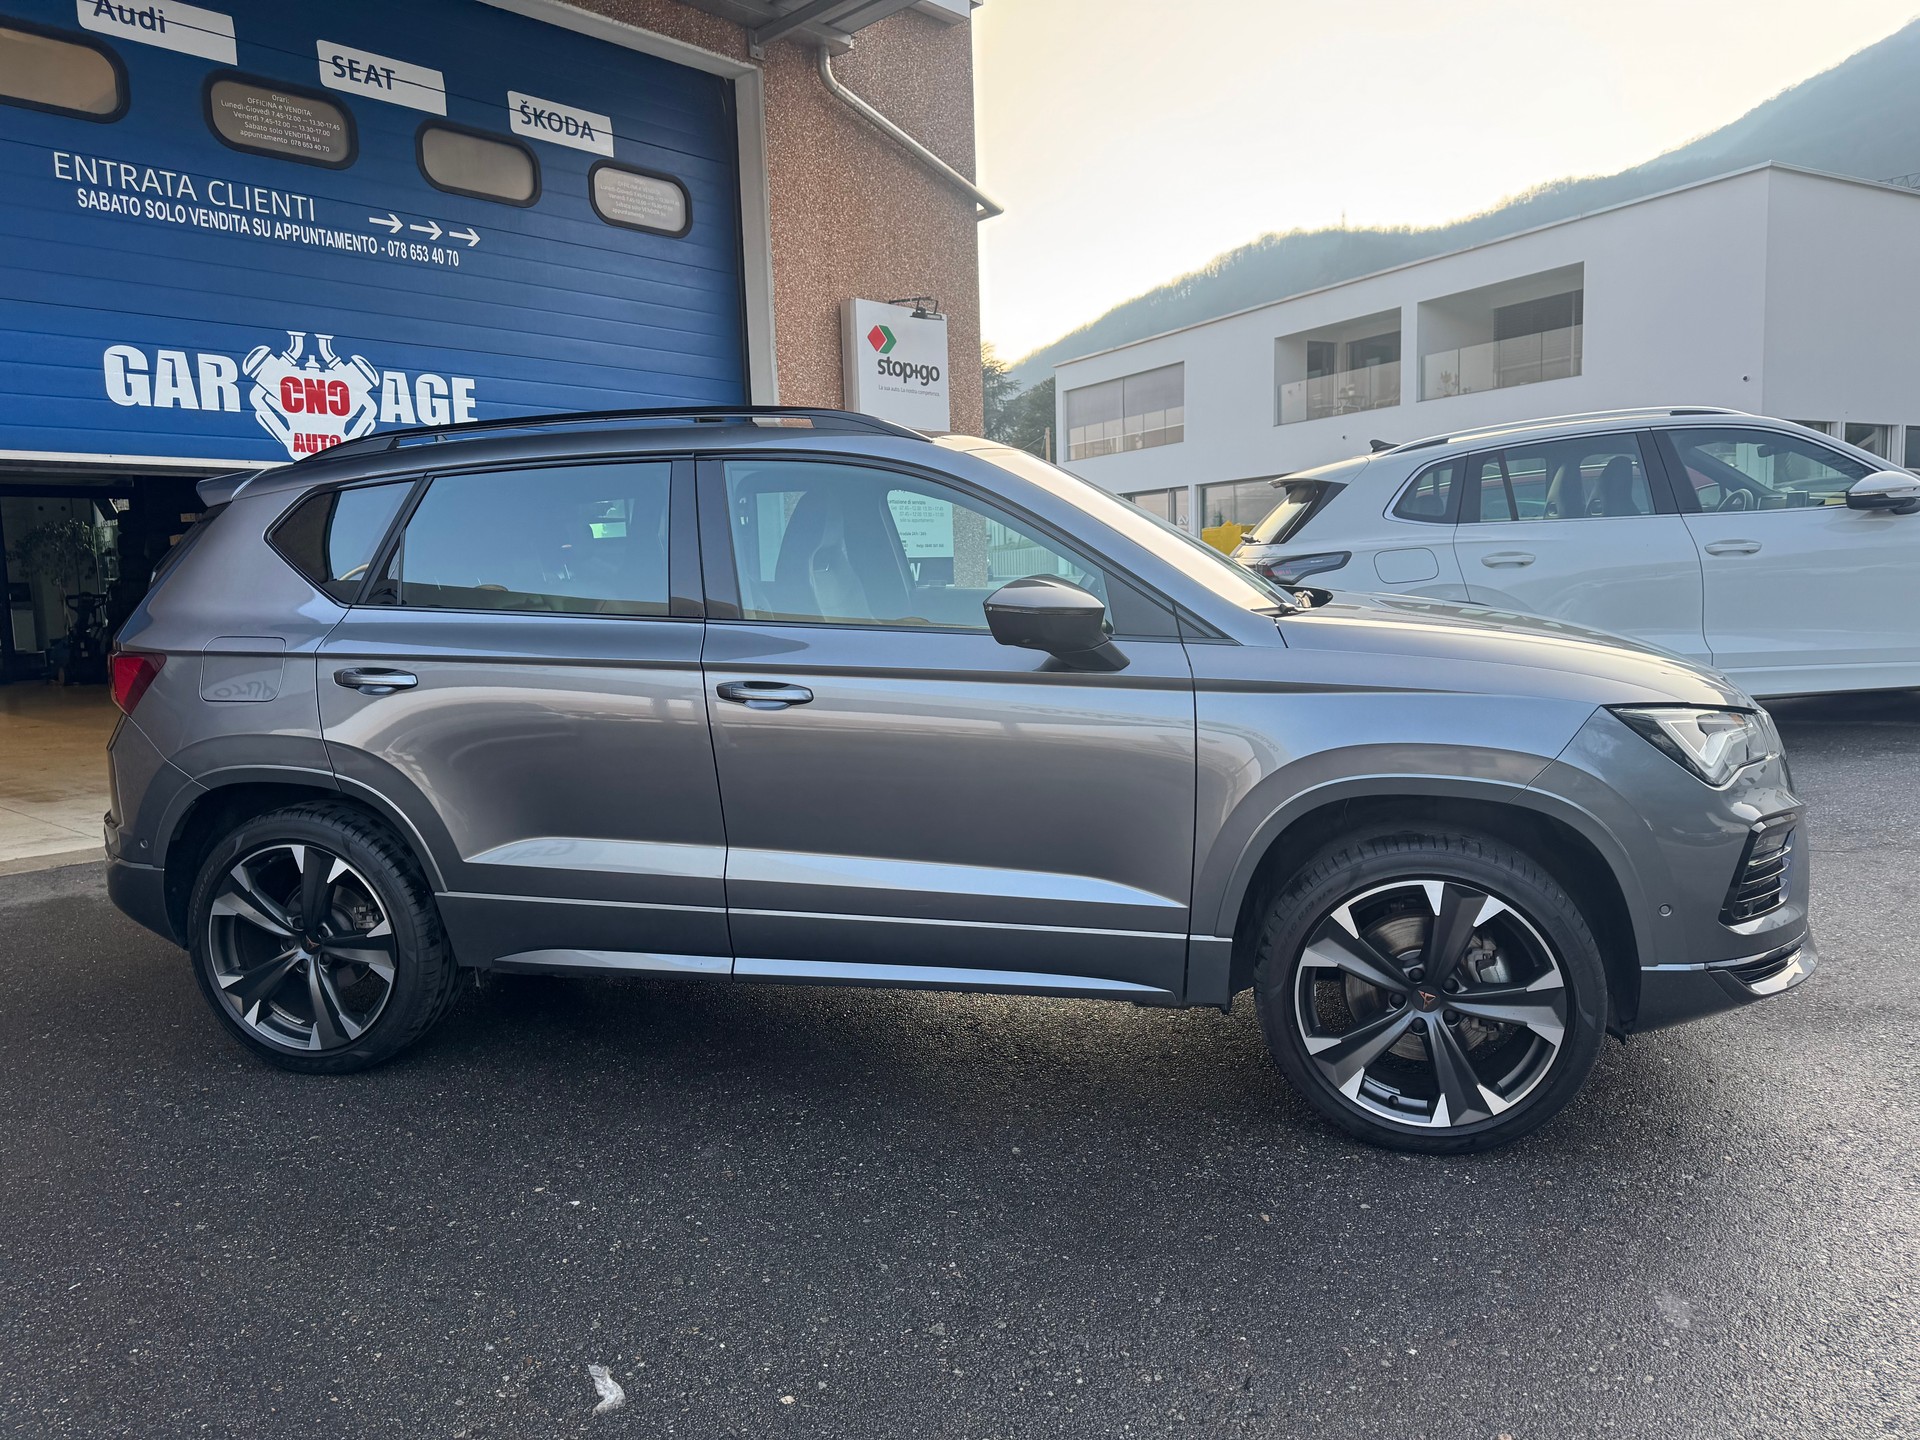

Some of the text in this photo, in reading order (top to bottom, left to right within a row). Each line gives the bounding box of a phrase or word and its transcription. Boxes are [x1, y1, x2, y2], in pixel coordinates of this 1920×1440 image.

[93, 0, 165, 33] Audi
[331, 55, 396, 90] SEAT
[247, 97, 277, 110] OFFICINA
[520, 100, 595, 141] ŠKODA
[240, 129, 288, 144] appuntamento
[290, 139, 302, 147] 078
[322, 145, 330, 153] 70
[244, 121, 268, 132] Sabato
[269, 127, 283, 135] solo
[284, 129, 311, 141] VENDITA
[53, 151, 315, 222] ENTRATA CLIENTI
[77, 188, 141, 217] SABATO
[145, 199, 186, 225] SOLO
[188, 205, 250, 235] VENDITA
[253, 217, 271, 238] SU
[274, 222, 378, 255] APPUNTAMENTO
[387, 240, 408, 260] 078
[410, 244, 429, 262] 653
[431, 248, 444, 264] 40
[446, 250, 460, 267] 70
[102, 344, 479, 427] GAR AGE
